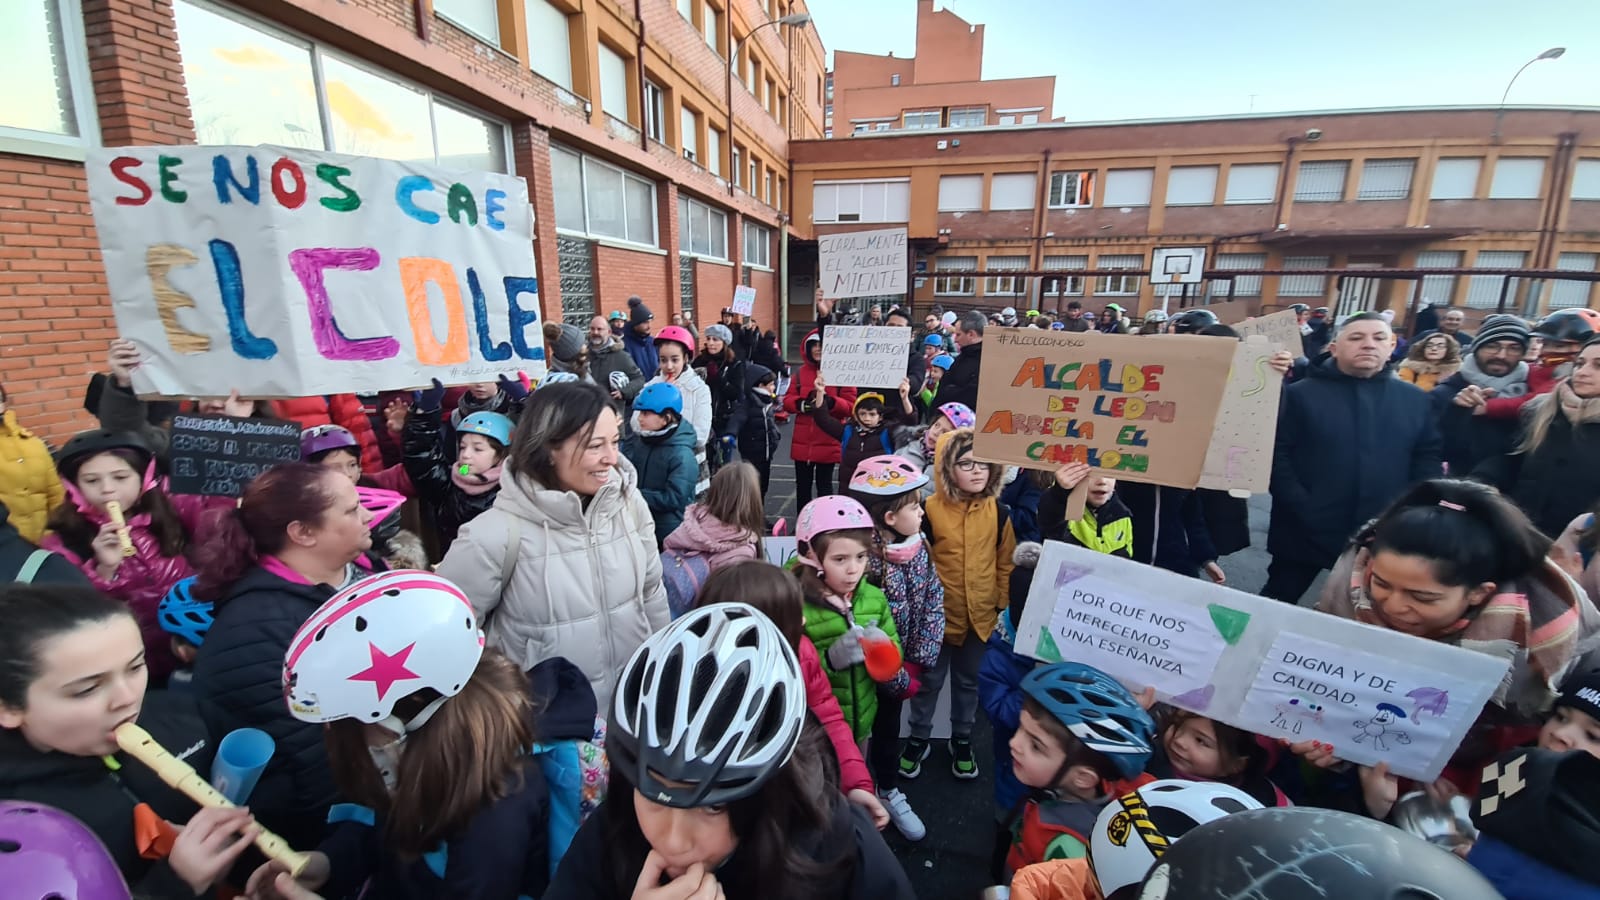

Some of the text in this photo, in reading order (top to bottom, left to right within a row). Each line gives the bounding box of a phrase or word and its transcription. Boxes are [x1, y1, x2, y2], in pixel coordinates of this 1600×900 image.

[109, 154, 507, 231] SE NOS CAE
[825, 258, 843, 272] EL
[833, 269, 905, 294] MIENTE
[145, 238, 545, 366] EL COLE
[823, 342, 861, 355] ALCALDE
[889, 358, 905, 370] EL
[835, 371, 890, 385] CANALÓN
[1011, 357, 1164, 393] ALCALDE
[1047, 393, 1176, 423] DE LEÓN
[981, 410, 1149, 447] ARREGLA EL
[223, 439, 240, 456] EL
[1026, 441, 1149, 473] CANALÓN
[172, 457, 198, 477] EL
[1072, 589, 1186, 633] POR QUE NOS
[1066, 608, 1170, 650] MERECEMOS
[1060, 627, 1183, 675] UNA ESEÑANZA
[1272, 671, 1359, 707] CALIDAD.
[1282, 651, 1397, 694] DIGNA Y DE
